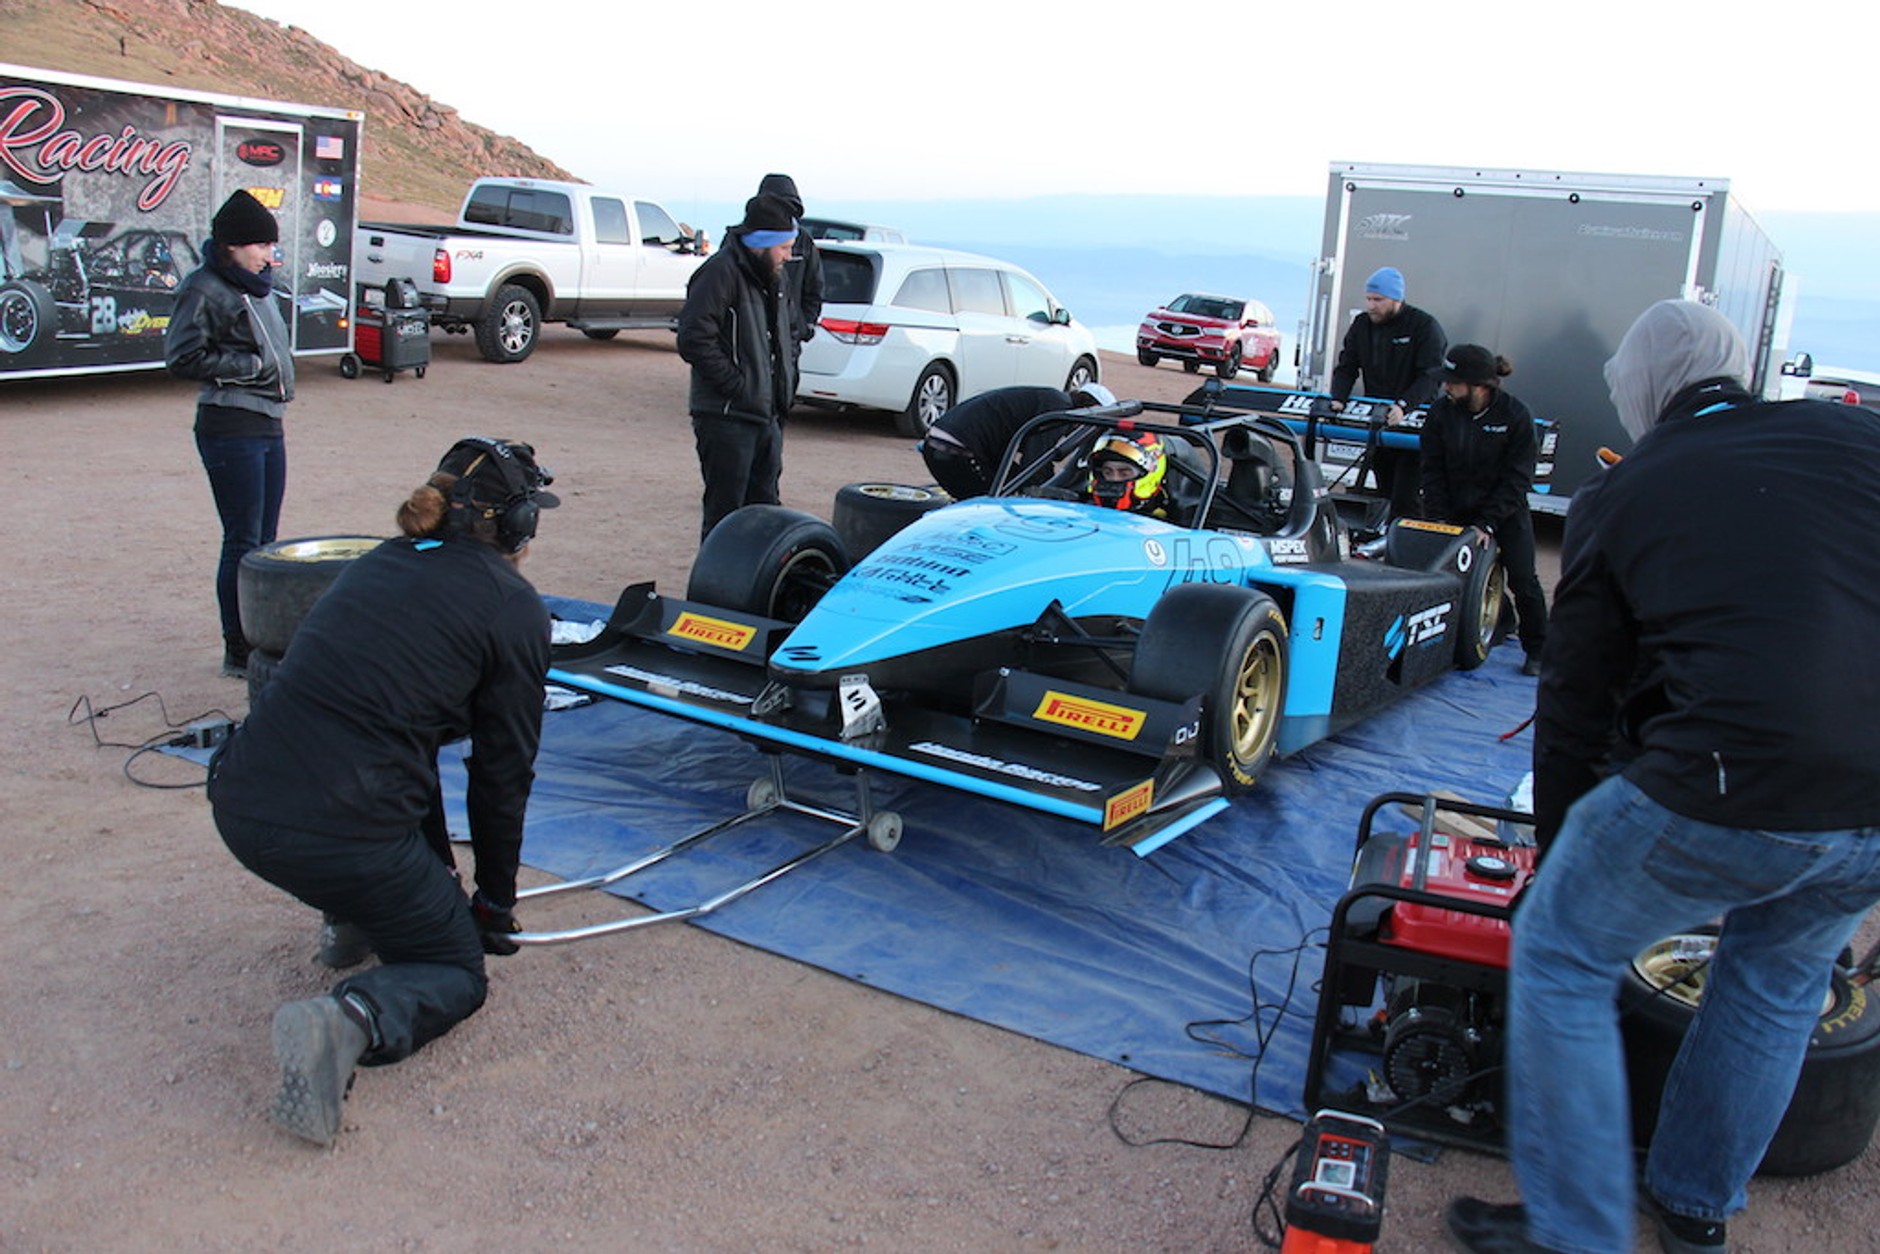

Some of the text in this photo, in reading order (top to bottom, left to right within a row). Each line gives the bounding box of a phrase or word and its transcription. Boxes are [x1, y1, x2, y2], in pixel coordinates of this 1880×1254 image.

[0, 86, 191, 211] Racing
[456, 250, 483, 260] FX4
[92, 296, 117, 334] 28
[679, 618, 746, 645] PIRELLI
[1046, 699, 1134, 734] PIRELLI
[1109, 786, 1149, 826] PIRELLI
